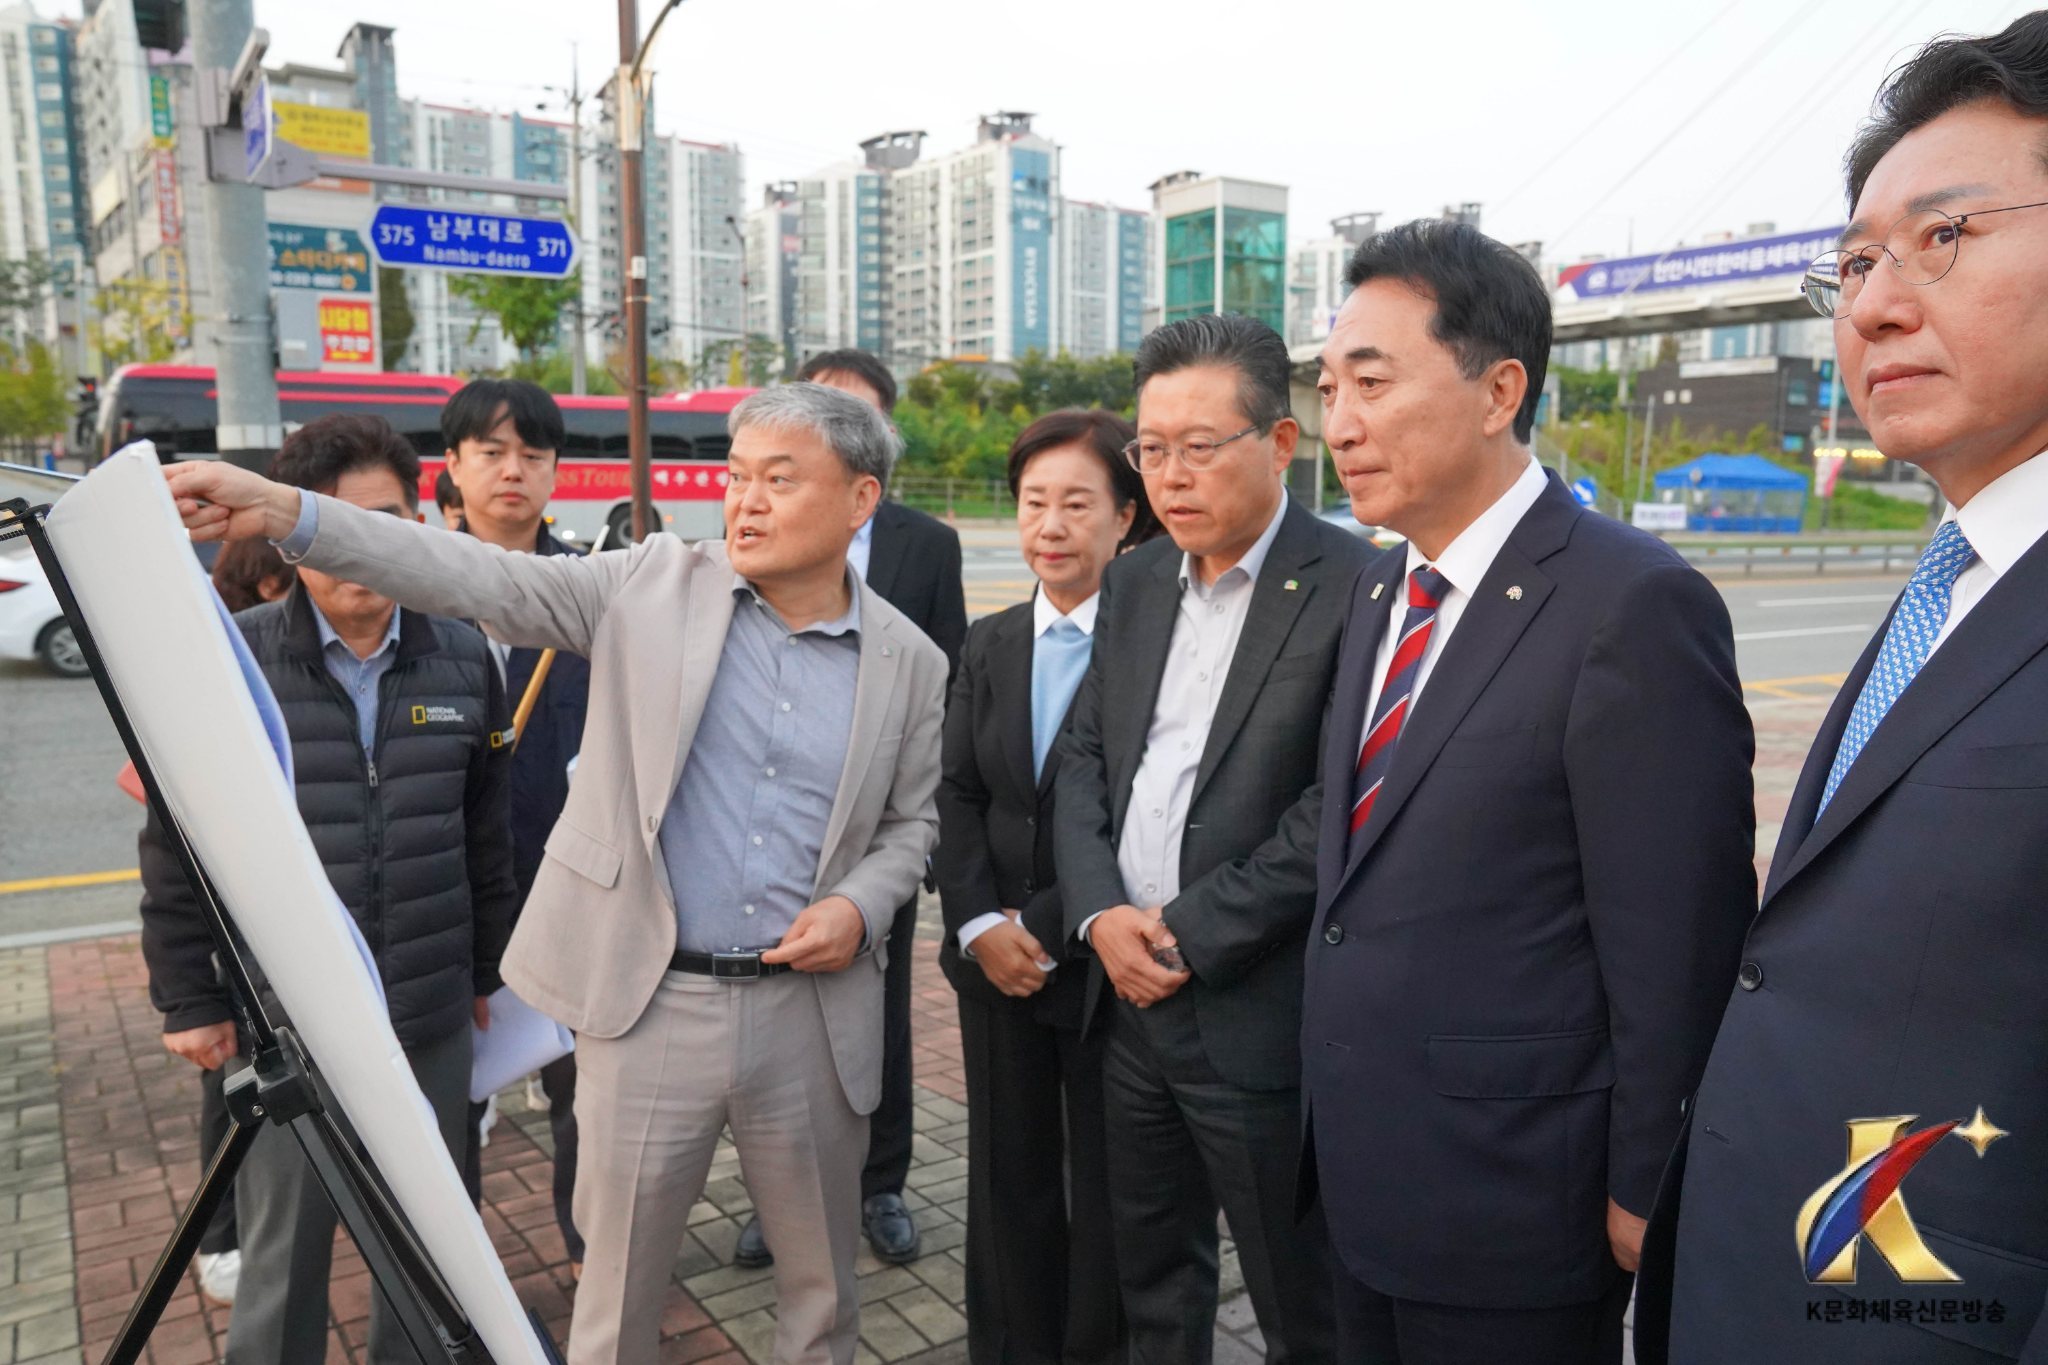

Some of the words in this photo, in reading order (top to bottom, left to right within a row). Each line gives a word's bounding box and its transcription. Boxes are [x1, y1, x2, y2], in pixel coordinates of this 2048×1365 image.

[378, 223, 415, 246] 375
[426, 214, 526, 244] 남부대로
[423, 244, 531, 269] Nambu-daero
[537, 236, 567, 258] 371
